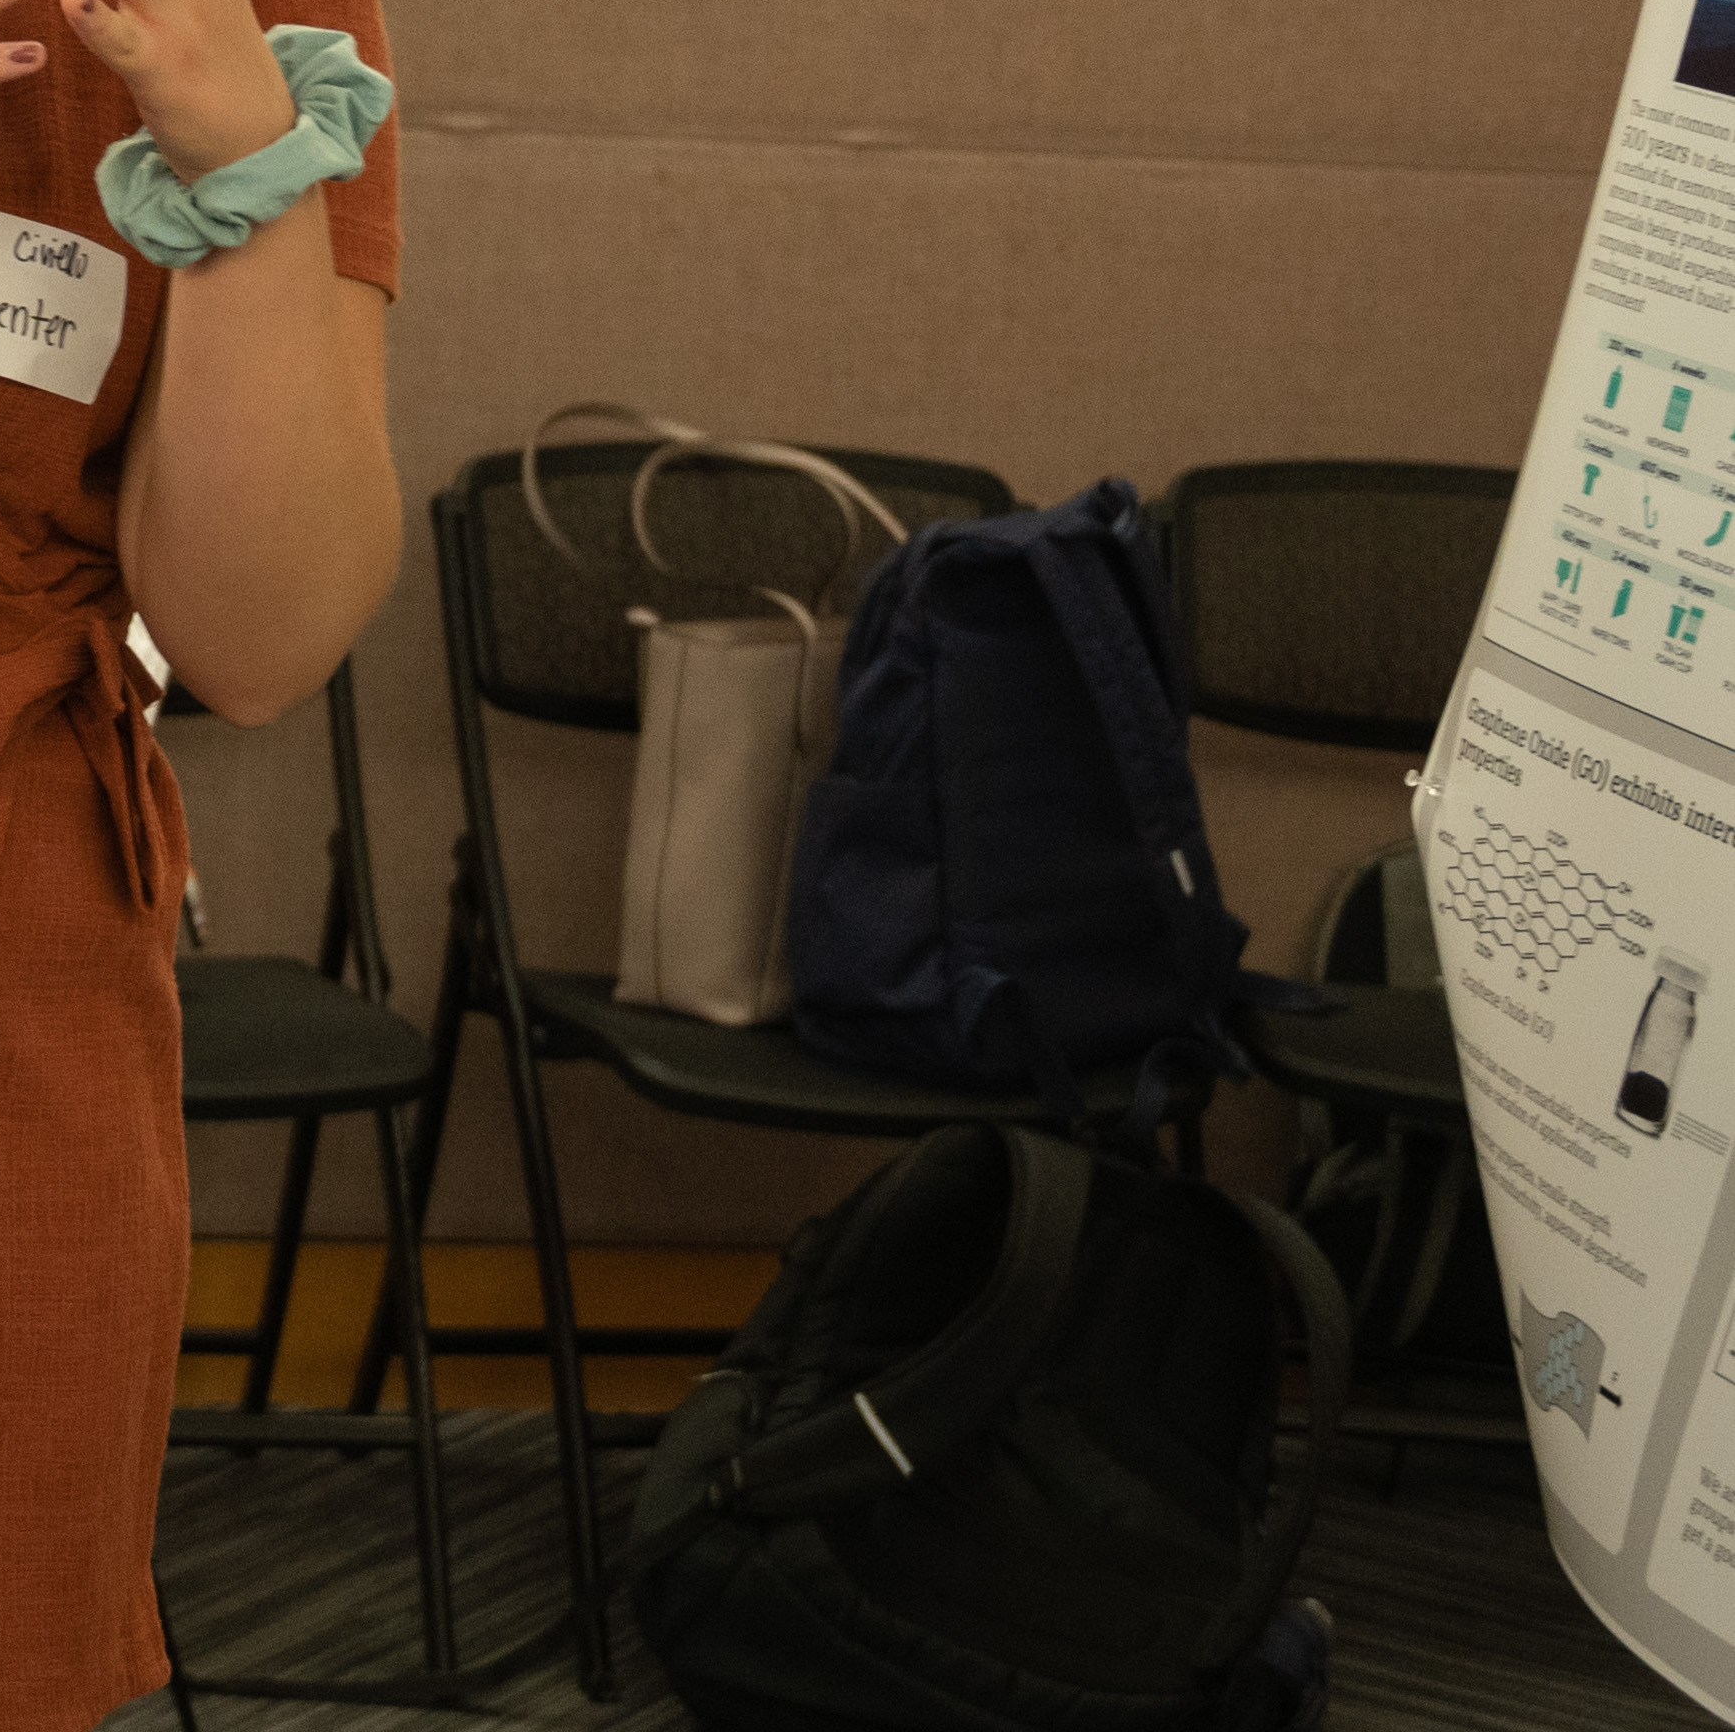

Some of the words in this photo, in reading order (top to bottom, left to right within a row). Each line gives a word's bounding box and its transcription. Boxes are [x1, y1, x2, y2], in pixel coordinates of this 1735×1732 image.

[1644, 137, 1692, 165] years
[1457, 737, 1523, 787] properties
[1570, 746, 1611, 793] (GO)
[1610, 774, 1683, 822] exhibits
